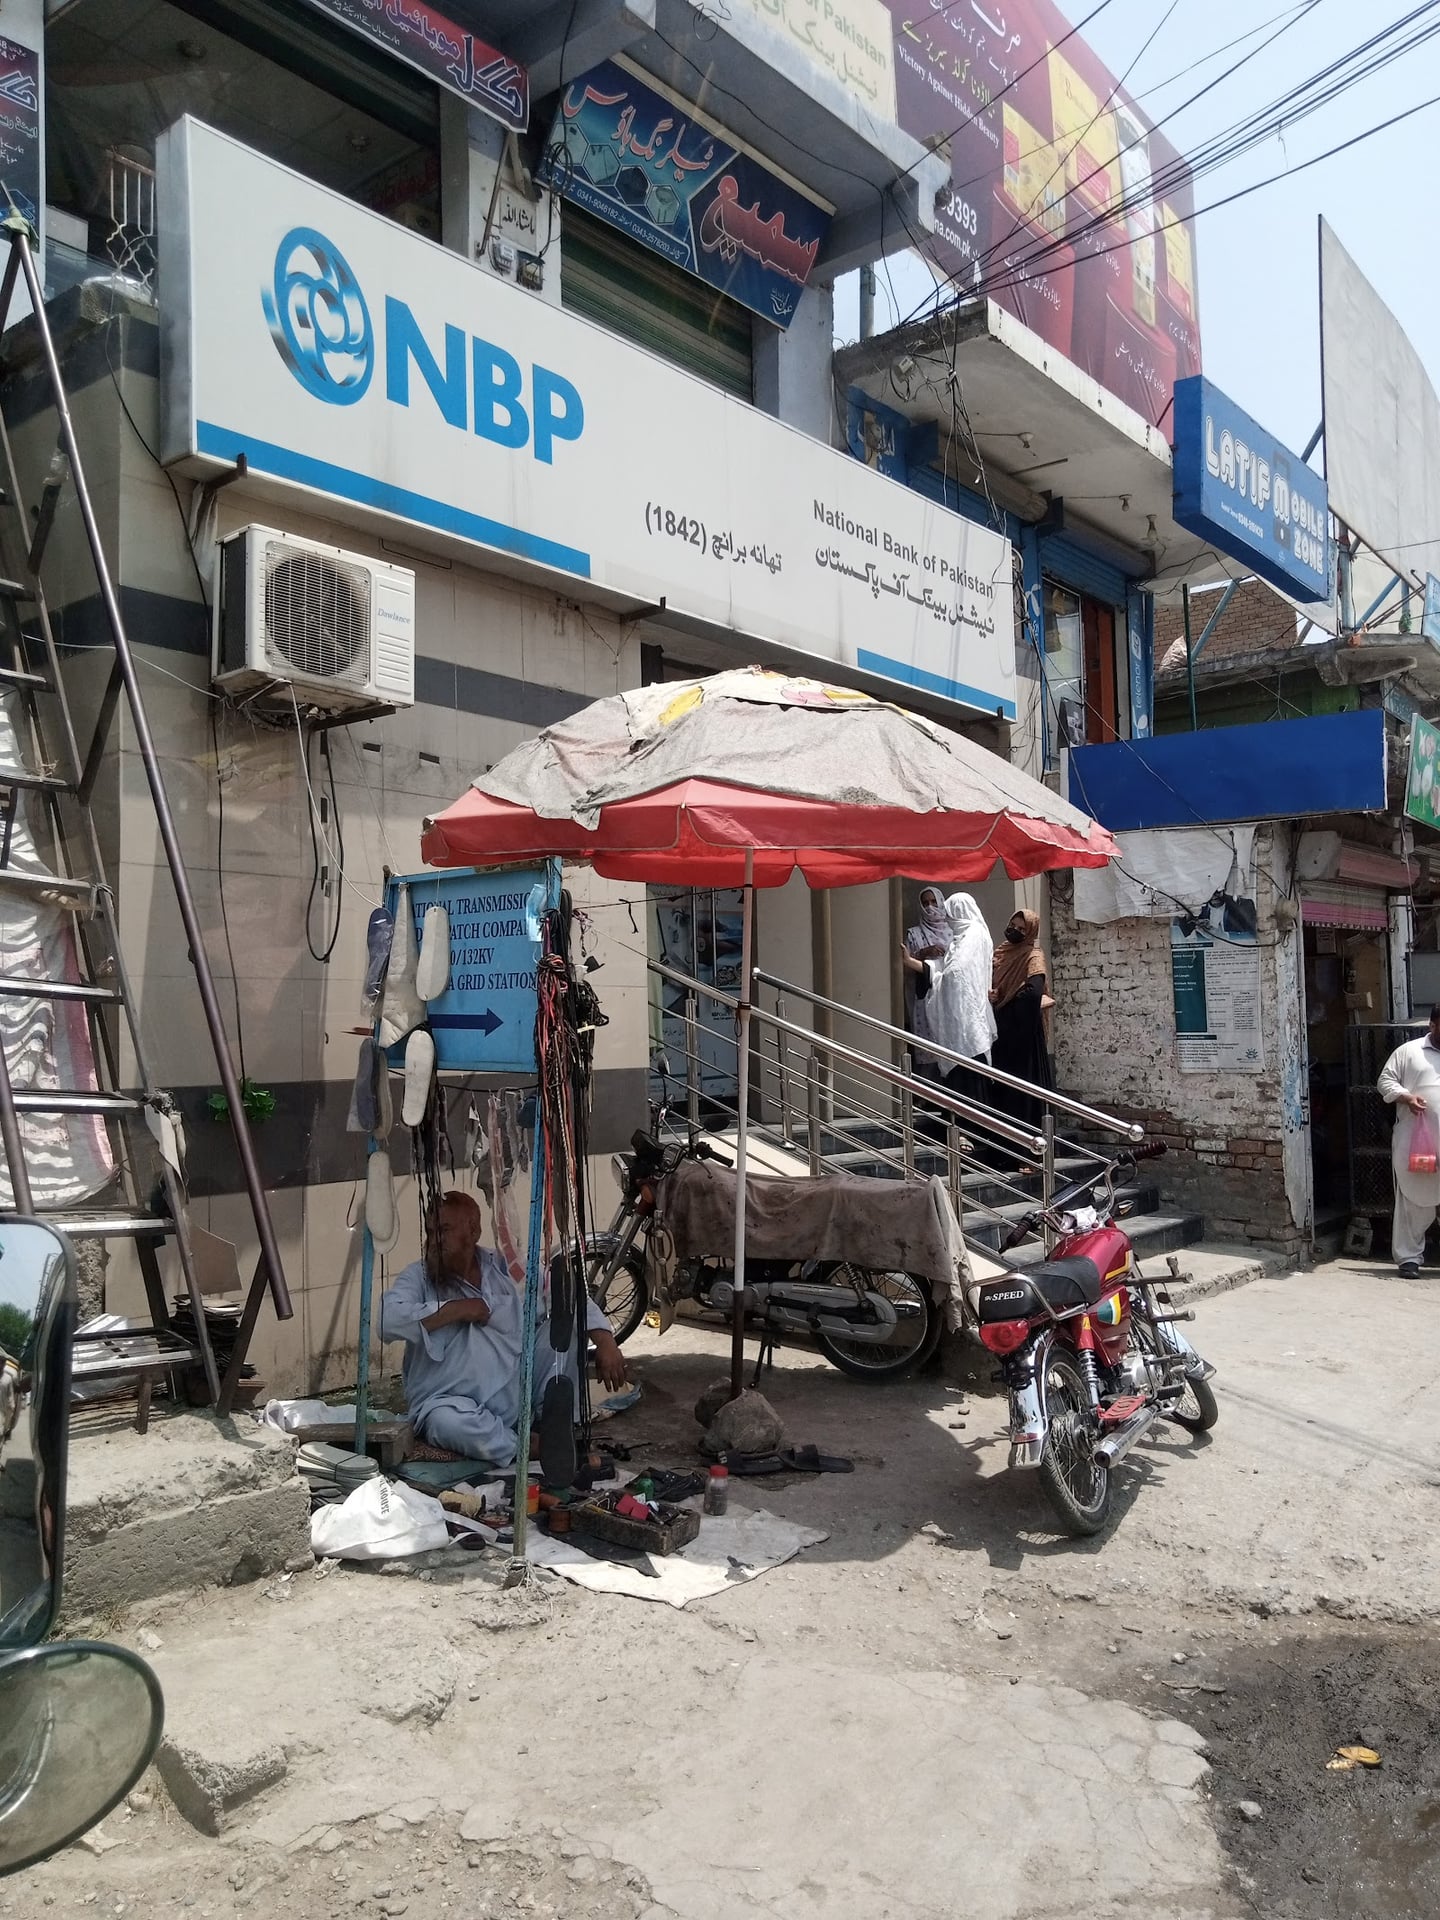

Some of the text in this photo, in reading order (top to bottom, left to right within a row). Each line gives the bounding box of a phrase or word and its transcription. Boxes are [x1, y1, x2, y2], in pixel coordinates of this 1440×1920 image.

[824, 5, 887, 69] Pakistan
[898, 44, 926, 80] Victory
[928, 72, 953, 103] Against
[978, 116, 1000, 149] Beauty
[384, 294, 585, 466] NBP
[1205, 415, 1271, 511] LATIF
[645, 501, 707, 554] (1842)
[813, 499, 993, 599] National Bank of Pakistan
[1294, 530, 1323, 575] ZONE
[815, 546, 881, 599] پاکستان
[906, 588, 947, 622] بینک
[949, 603, 995, 639] نیشنل
[458, 974, 485, 990] GRID
[488, 971, 537, 990] STATION
[992, 1290, 1024, 1302] SPEED
